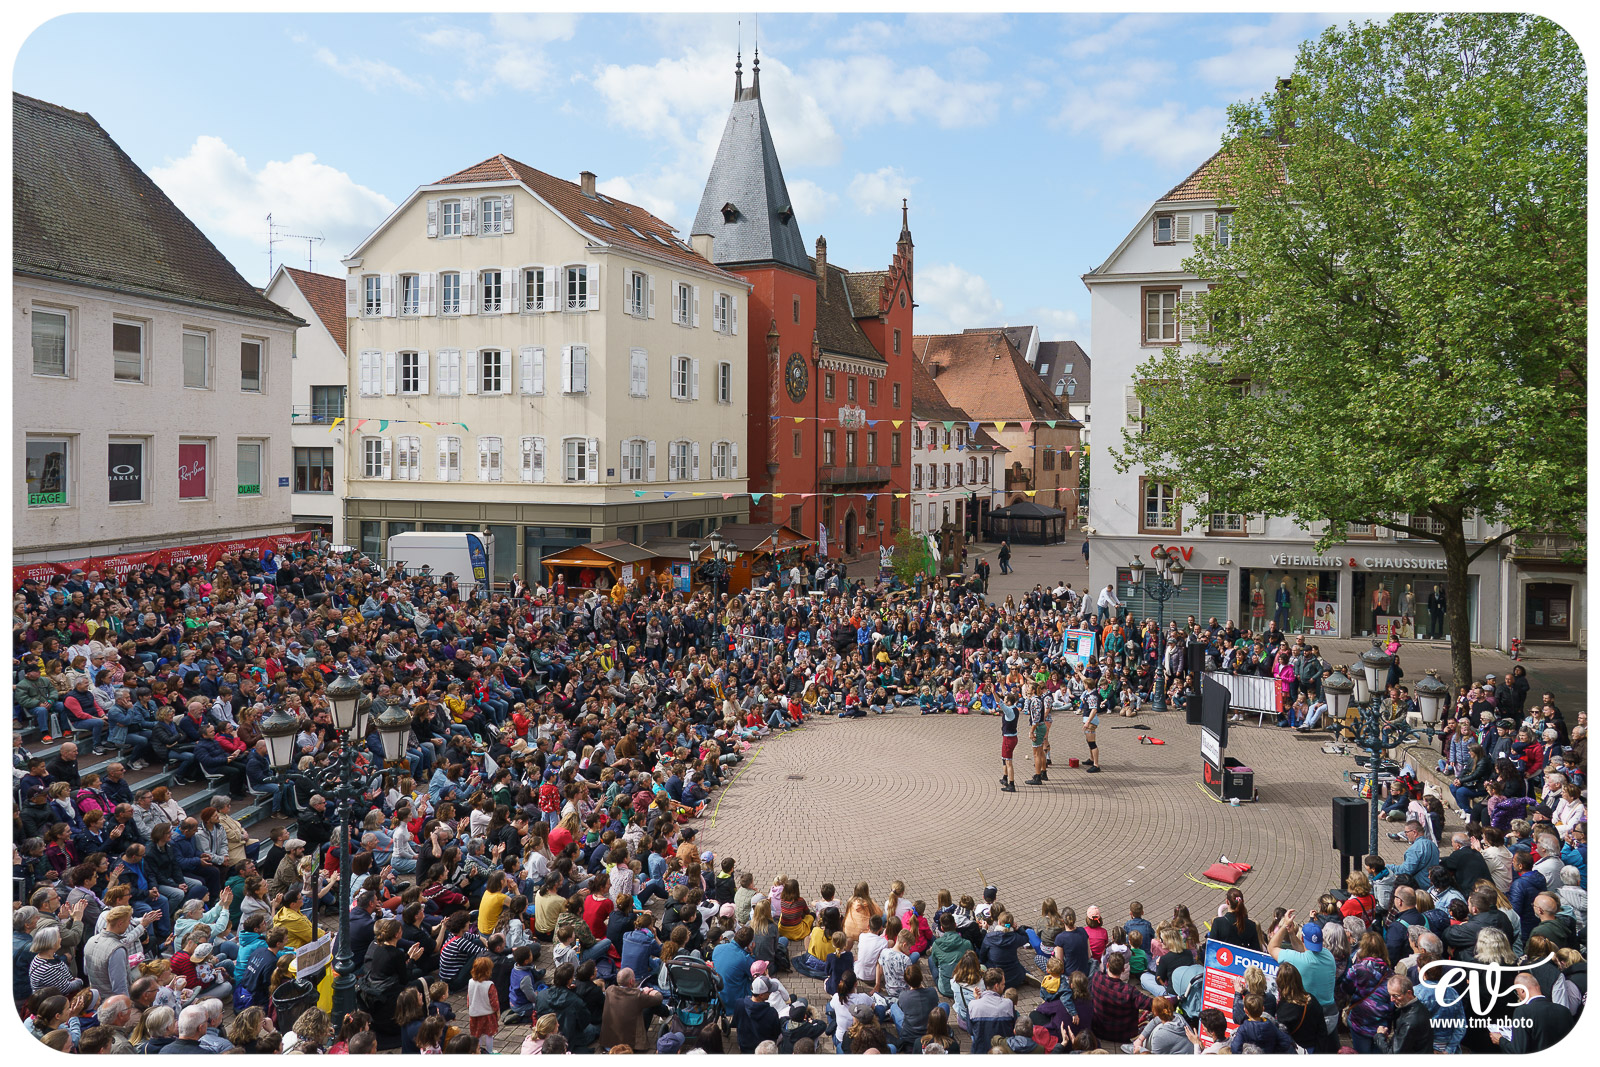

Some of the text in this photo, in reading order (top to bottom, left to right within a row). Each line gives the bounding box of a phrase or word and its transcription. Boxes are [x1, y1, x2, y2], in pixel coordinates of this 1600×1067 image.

[178, 460, 205, 481] Ray-Ban
[30, 493, 61, 505] ETAGE
[104, 558, 129, 567] FESTIVAL
[1270, 553, 1343, 567] VÊTEMENTS
[1348, 558, 1357, 567] &
[28, 567, 56, 576] FESTIVAL
[1202, 576, 1226, 585] CCV
[1220, 952, 1228, 962] 4
